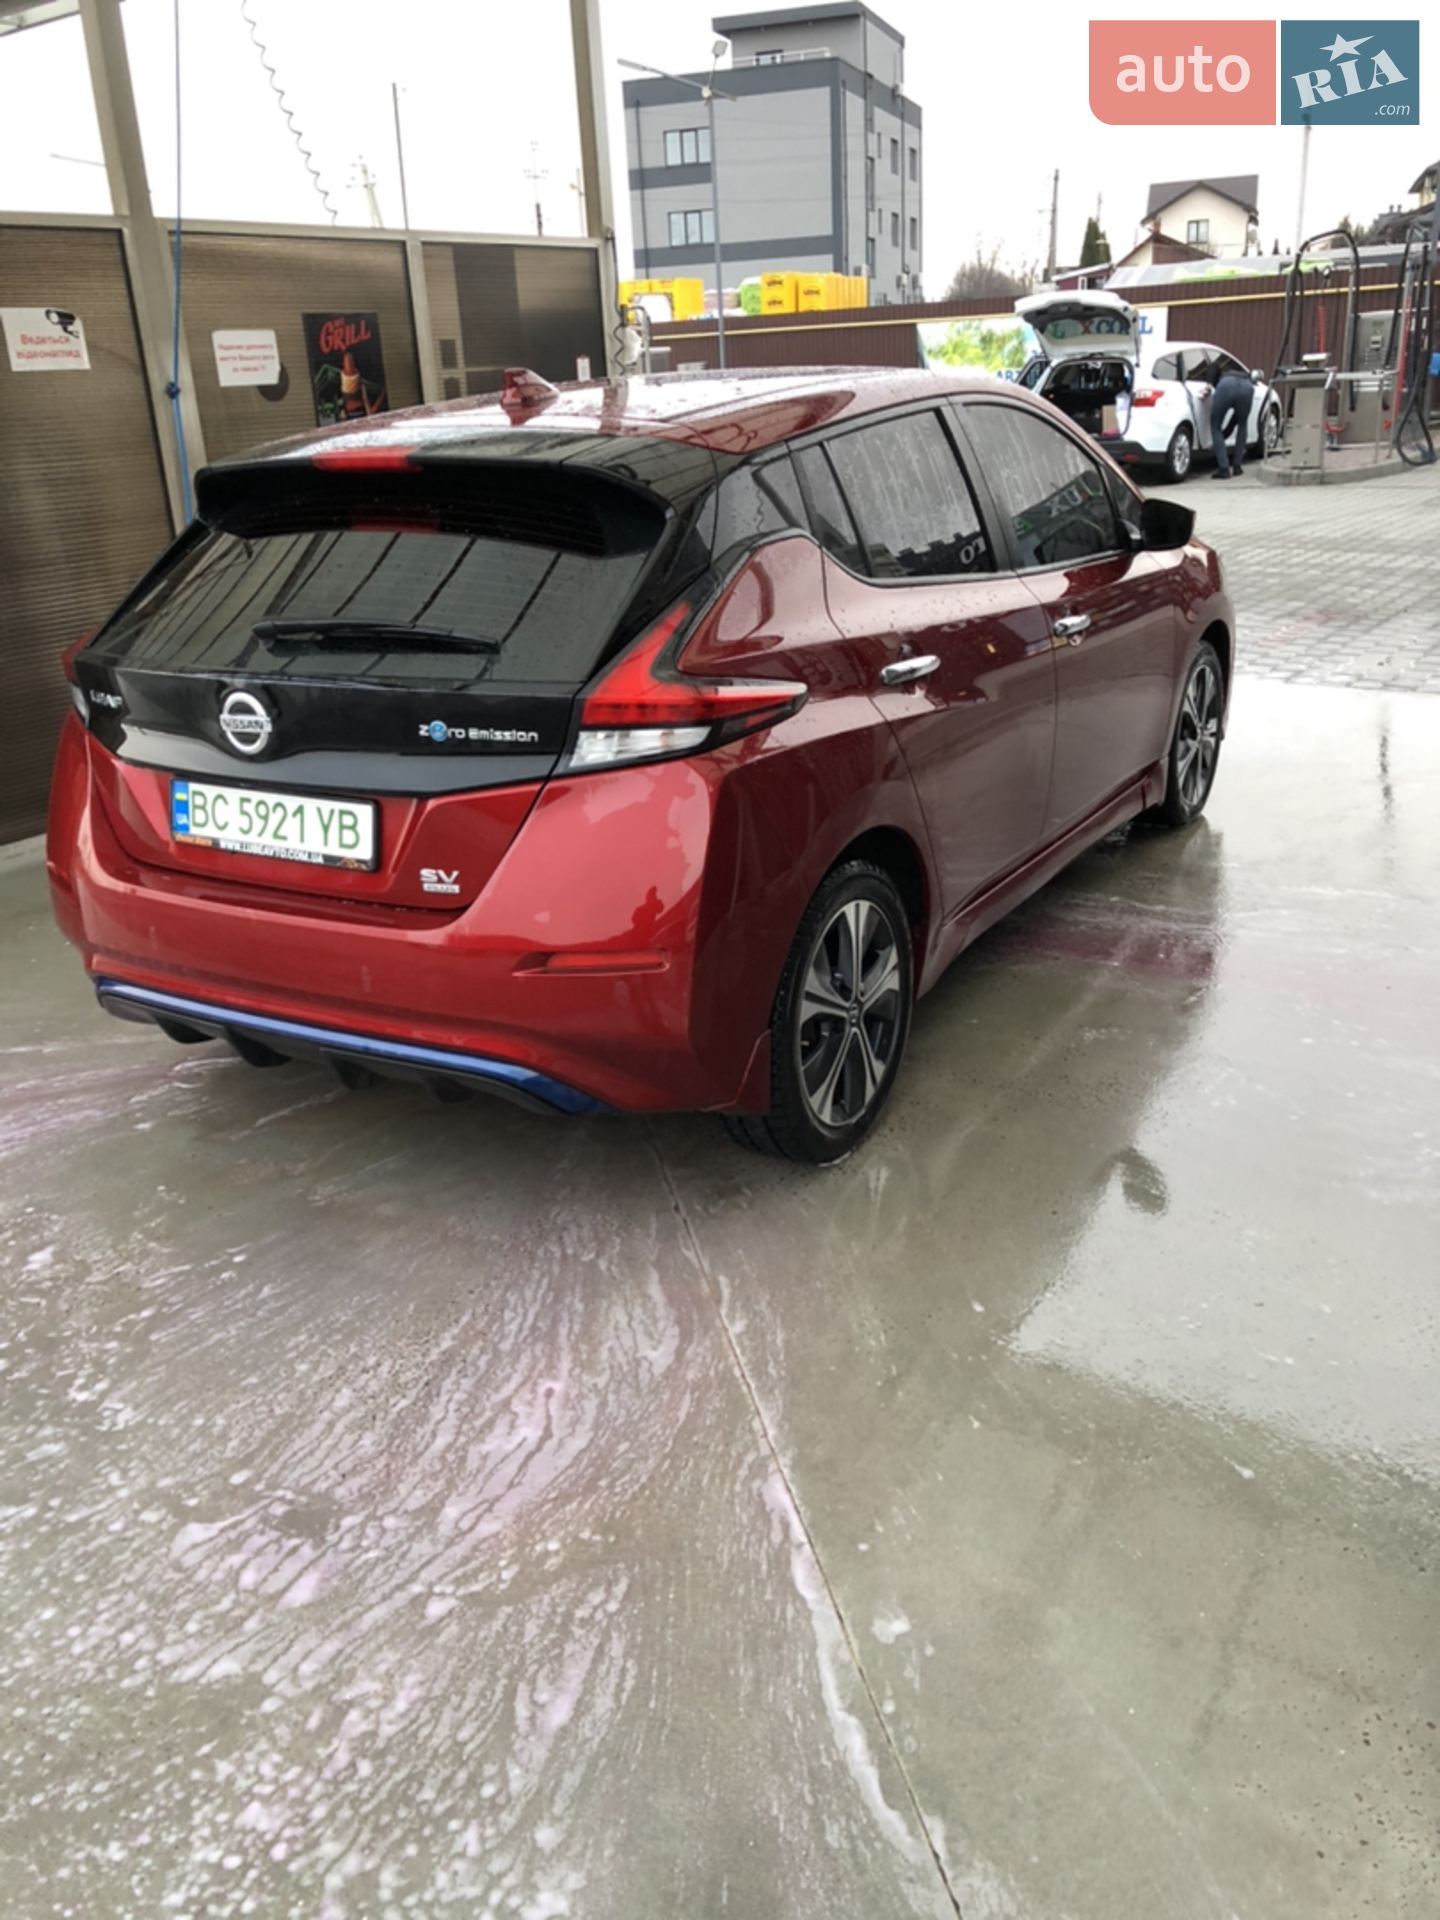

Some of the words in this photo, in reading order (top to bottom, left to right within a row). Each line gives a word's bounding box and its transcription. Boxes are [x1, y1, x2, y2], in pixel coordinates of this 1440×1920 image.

[319, 319, 372, 354] GRILL
[222, 718, 265, 731] NISSAN
[191, 789, 230, 832] BC
[238, 796, 305, 844] 5921
[316, 806, 361, 850] YB
[419, 867, 460, 884] SV
